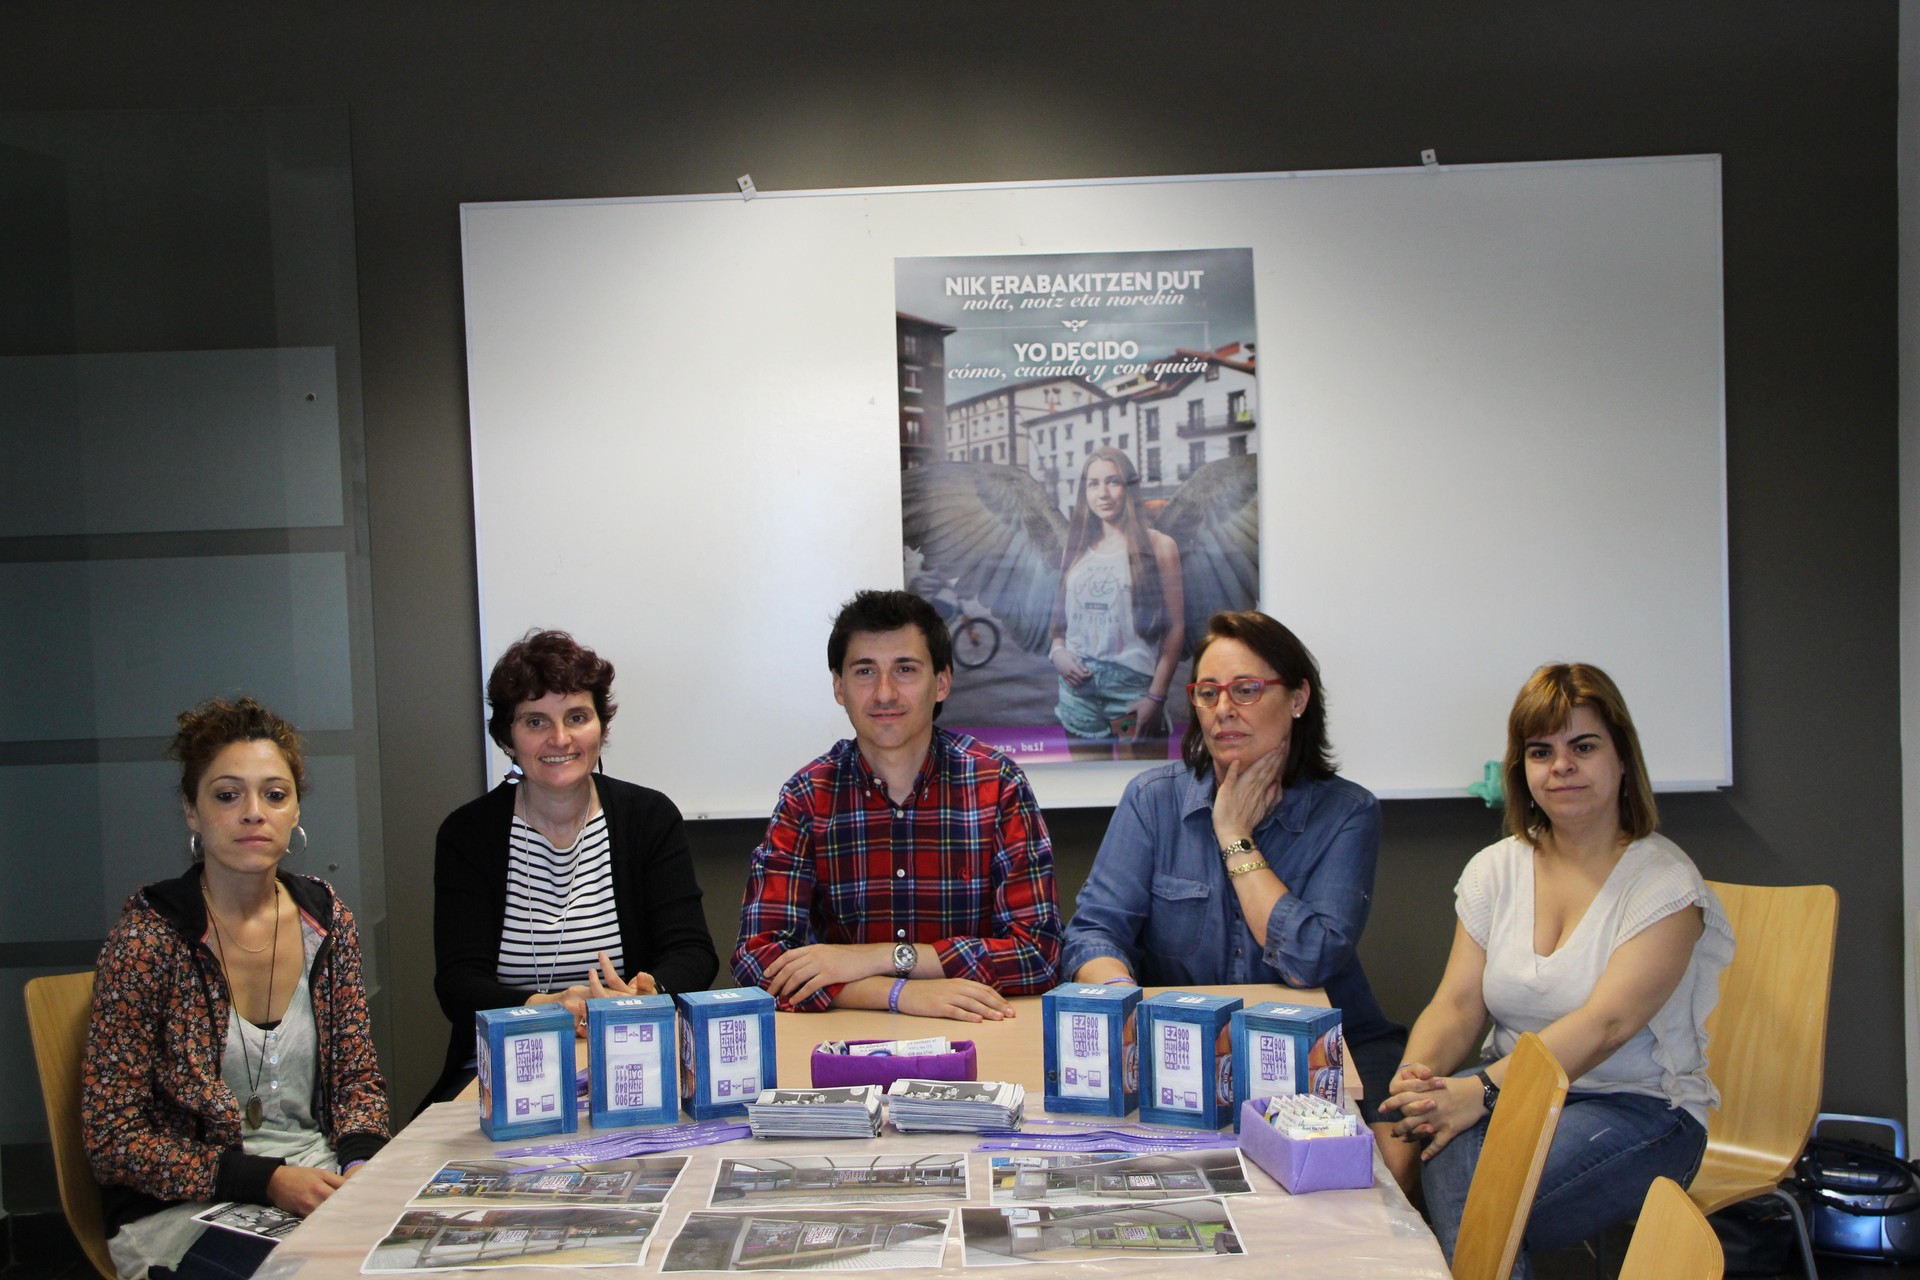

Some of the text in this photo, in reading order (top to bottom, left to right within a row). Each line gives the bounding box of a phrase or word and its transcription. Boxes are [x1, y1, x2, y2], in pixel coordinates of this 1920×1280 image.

[945, 269, 1205, 297] NIK ERABAKITZEN DUT
[962, 287, 1186, 313] nola, noiz eta norekin
[1012, 339, 1139, 364] YO DECIDO
[947, 356, 1210, 384] cómo, cuándo y con quién
[720, 1021, 733, 1034] EZ
[734, 1020, 747, 1032] 900
[1073, 1016, 1086, 1028] EZ
[1087, 1017, 1098, 1029] 900
[735, 1032, 747, 1044] 840
[1087, 1029, 1098, 1040] 840
[1165, 1027, 1177, 1040] EZ
[1178, 1028, 1189, 1040] 900
[516, 1040, 530, 1054] EZ
[531, 1039, 543, 1050] 900
[735, 1044, 747, 1055] 111
[1074, 1041, 1086, 1051] DA!
[1087, 1041, 1098, 1051] 111
[1178, 1041, 1189, 1053] 840
[1261, 1037, 1273, 1050] EZ
[1274, 1038, 1286, 1050] 900
[532, 1050, 544, 1062] 840
[721, 1047, 735, 1057] DA!
[1275, 1051, 1286, 1063] 840
[1165, 1053, 1177, 1064] DA!
[1178, 1053, 1189, 1065] 111
[518, 1066, 531, 1076] DA!
[532, 1062, 543, 1074] 111
[1262, 1064, 1275, 1074] DA!
[1275, 1063, 1286, 1075] 111
[616, 1070, 628, 1081] 111
[629, 1070, 642, 1079] DA!
[615, 1082, 628, 1093] 840
[615, 1094, 628, 1106] 900
[629, 1093, 643, 1105] EZ
